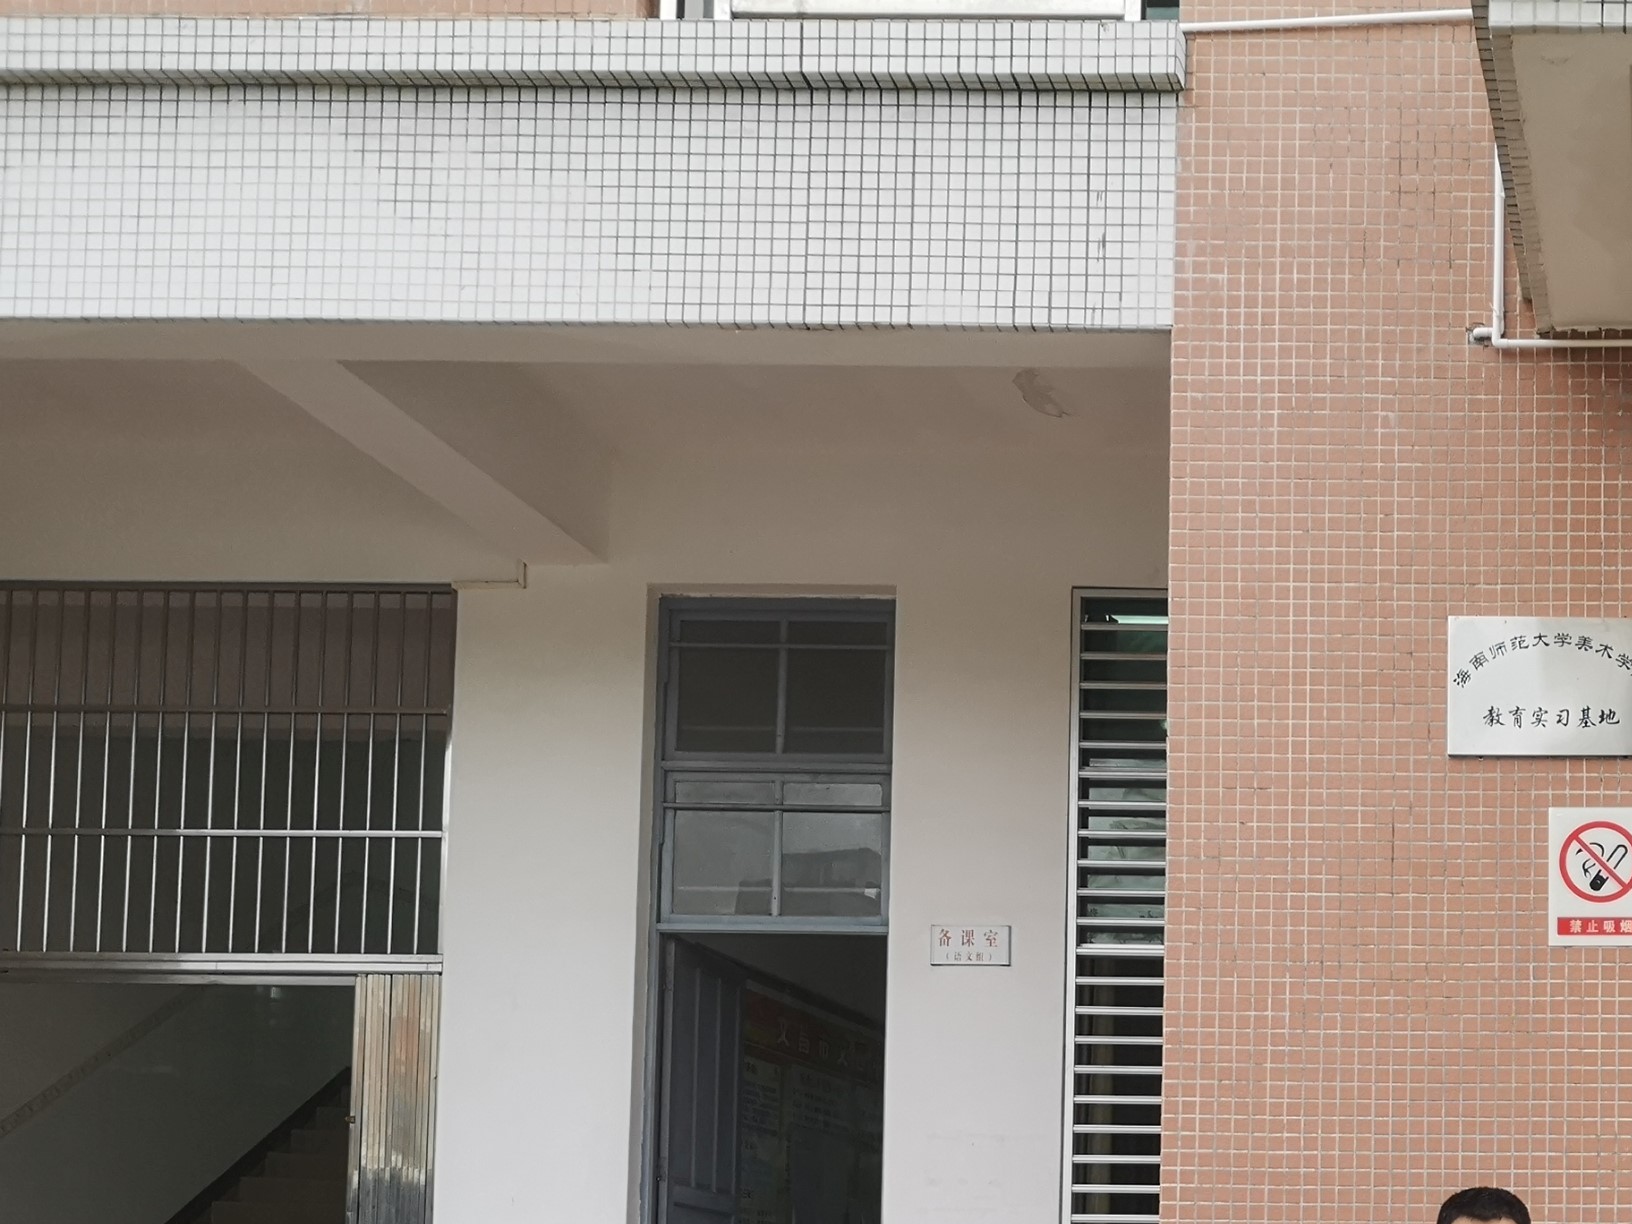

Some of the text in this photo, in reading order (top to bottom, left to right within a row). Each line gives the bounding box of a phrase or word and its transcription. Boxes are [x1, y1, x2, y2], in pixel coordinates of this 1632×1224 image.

[1483, 706, 1620, 729] 教育实习基地
[1569, 918, 1632, 934] 禁止吸烟
[938, 928, 999, 948] 备课室
